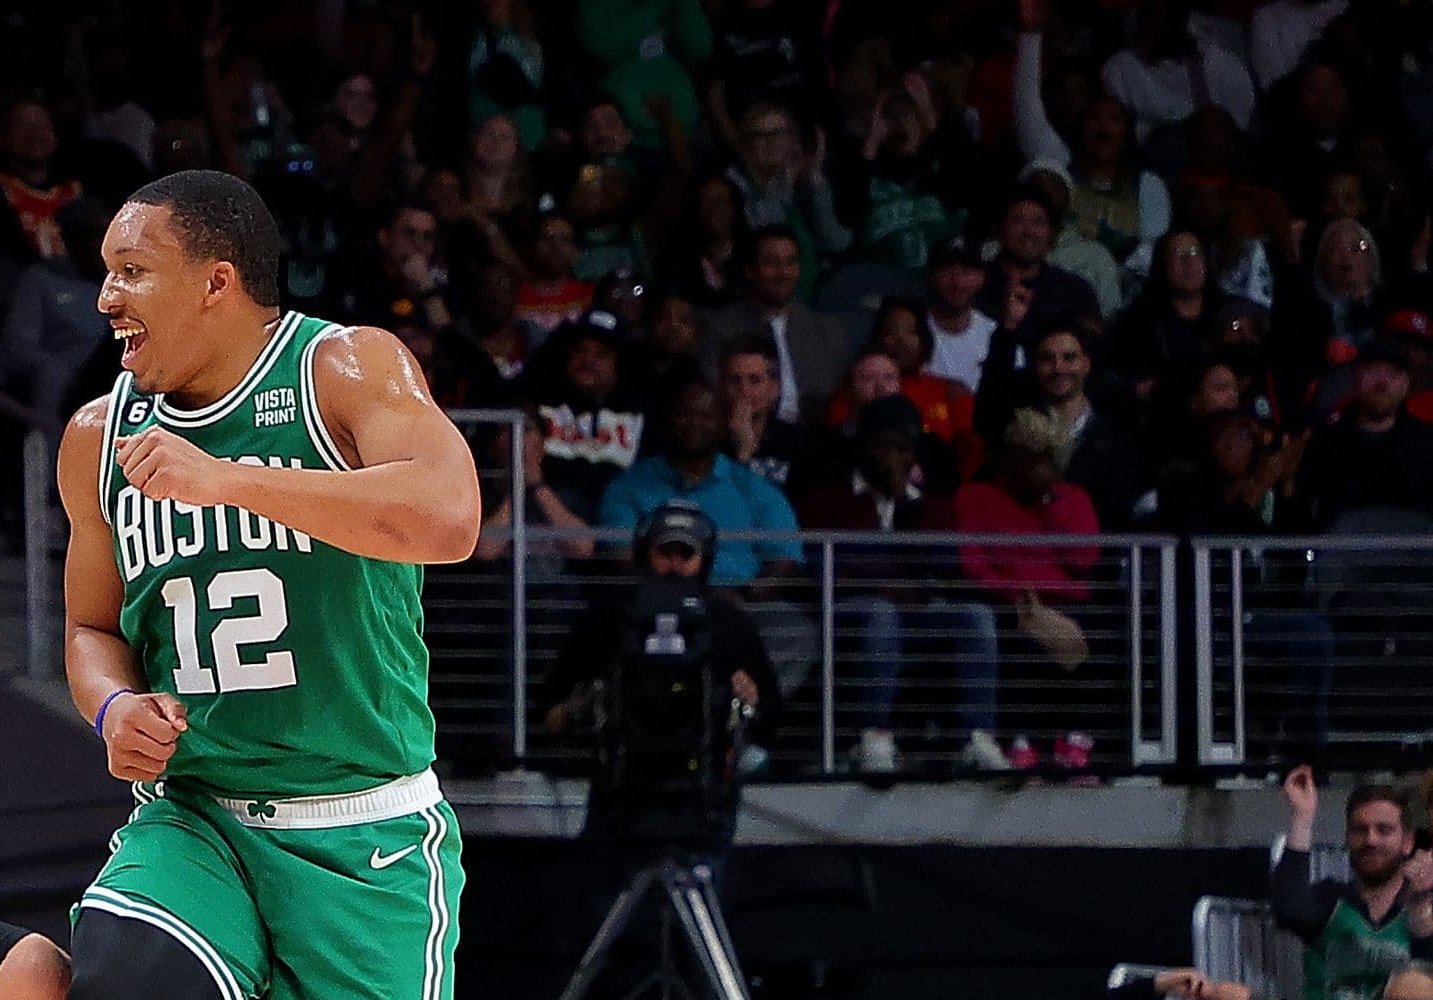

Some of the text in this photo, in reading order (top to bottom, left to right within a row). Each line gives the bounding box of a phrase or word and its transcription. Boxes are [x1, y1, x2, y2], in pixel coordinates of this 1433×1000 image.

[254, 388, 296, 412] VISTA
[127, 401, 149, 423] 6
[255, 407, 297, 428] PRINT
[160, 568, 297, 694] 12
